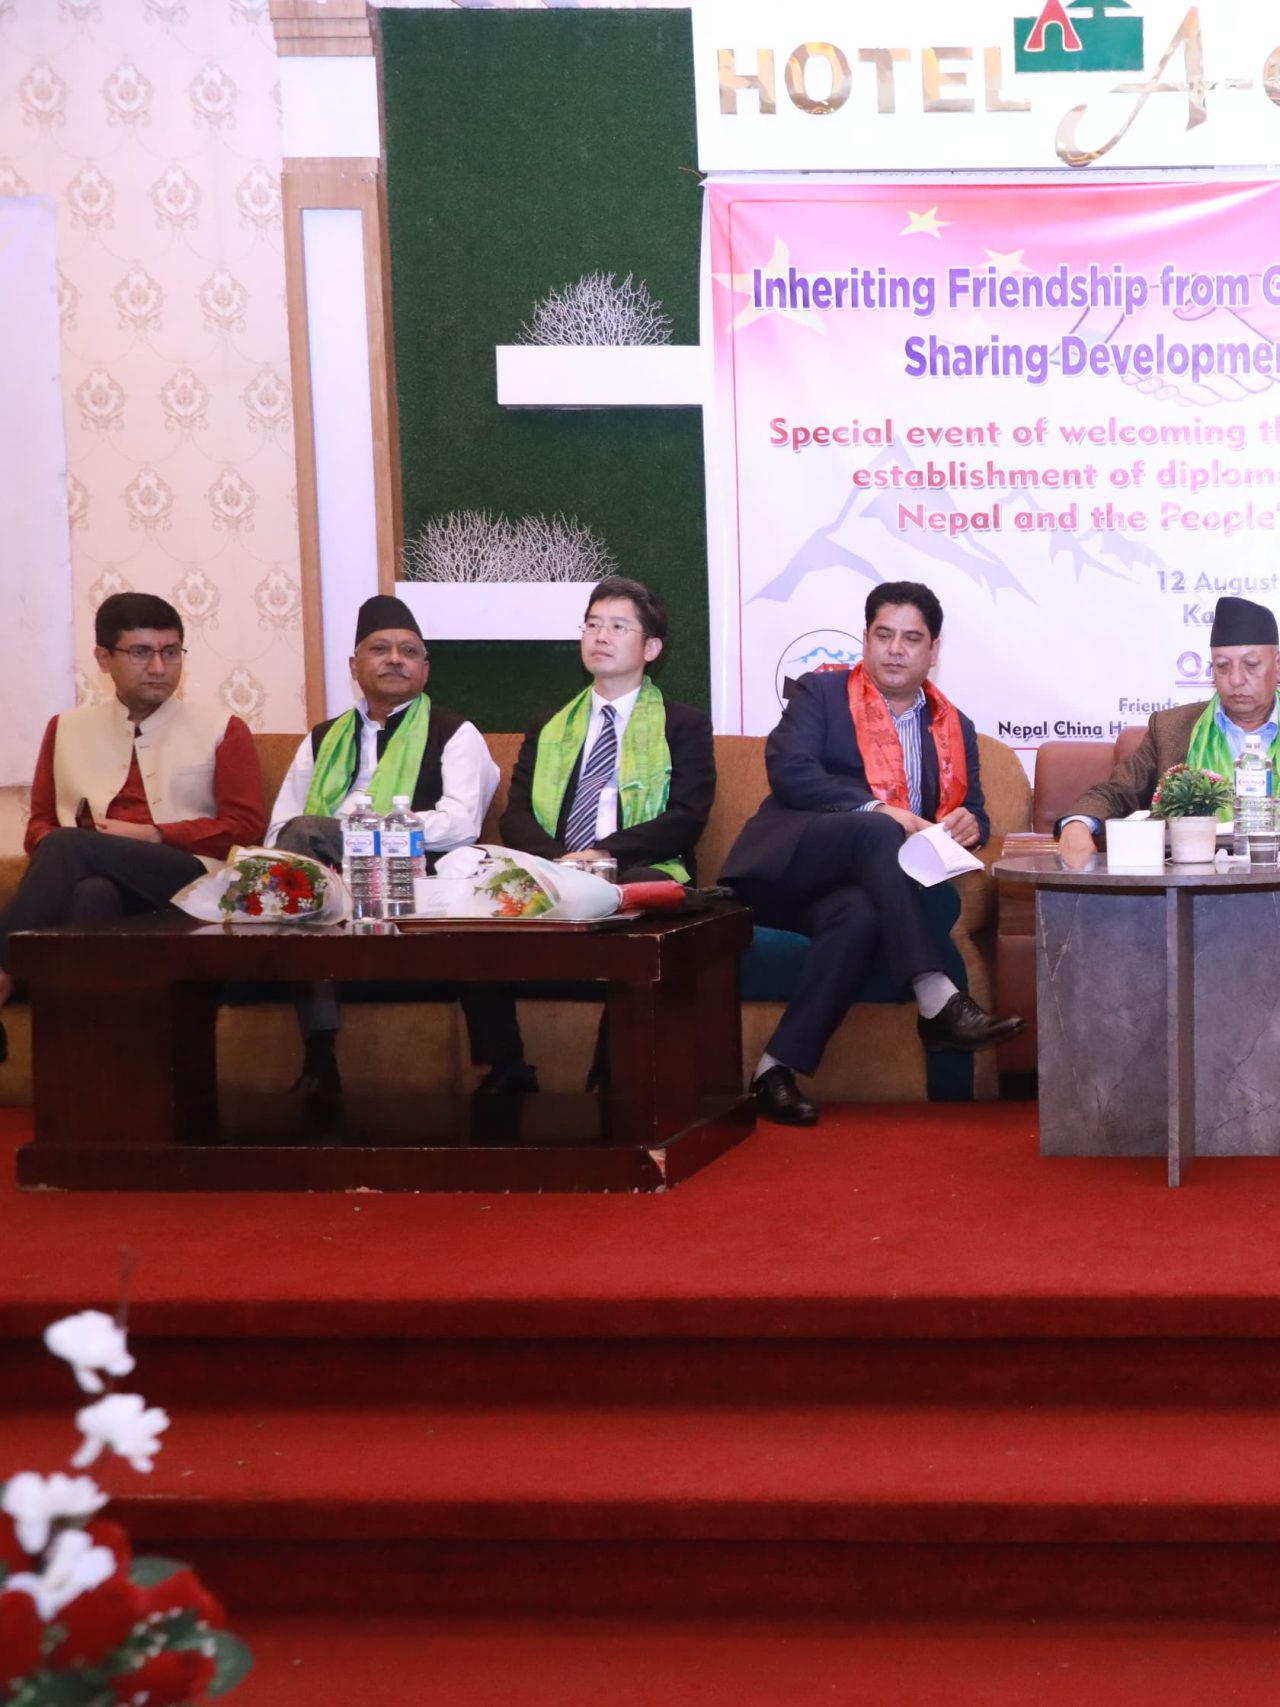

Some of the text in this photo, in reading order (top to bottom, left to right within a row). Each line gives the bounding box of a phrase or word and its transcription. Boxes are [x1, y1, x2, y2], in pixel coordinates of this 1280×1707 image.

[717, 42, 1031, 115] HOTEL
[753, 267, 936, 317] Inheriting
[948, 265, 1148, 316] Friendship
[1160, 265, 1250, 307] from
[904, 335, 1049, 385] Sharing
[769, 417, 893, 452] Special
[906, 422, 1001, 445] event
[1012, 417, 1048, 444] of
[1058, 416, 1247, 450] welcoming
[852, 460, 1097, 488] establishment
[1109, 459, 1145, 487] of
[898, 502, 1000, 537] Nepal
[1014, 502, 1078, 530] and
[1090, 502, 1148, 530] the
[1157, 570, 1186, 591] 12
[1193, 570, 1279, 595] August
[998, 721, 1048, 740] Nepal
[1053, 720, 1103, 736] China
